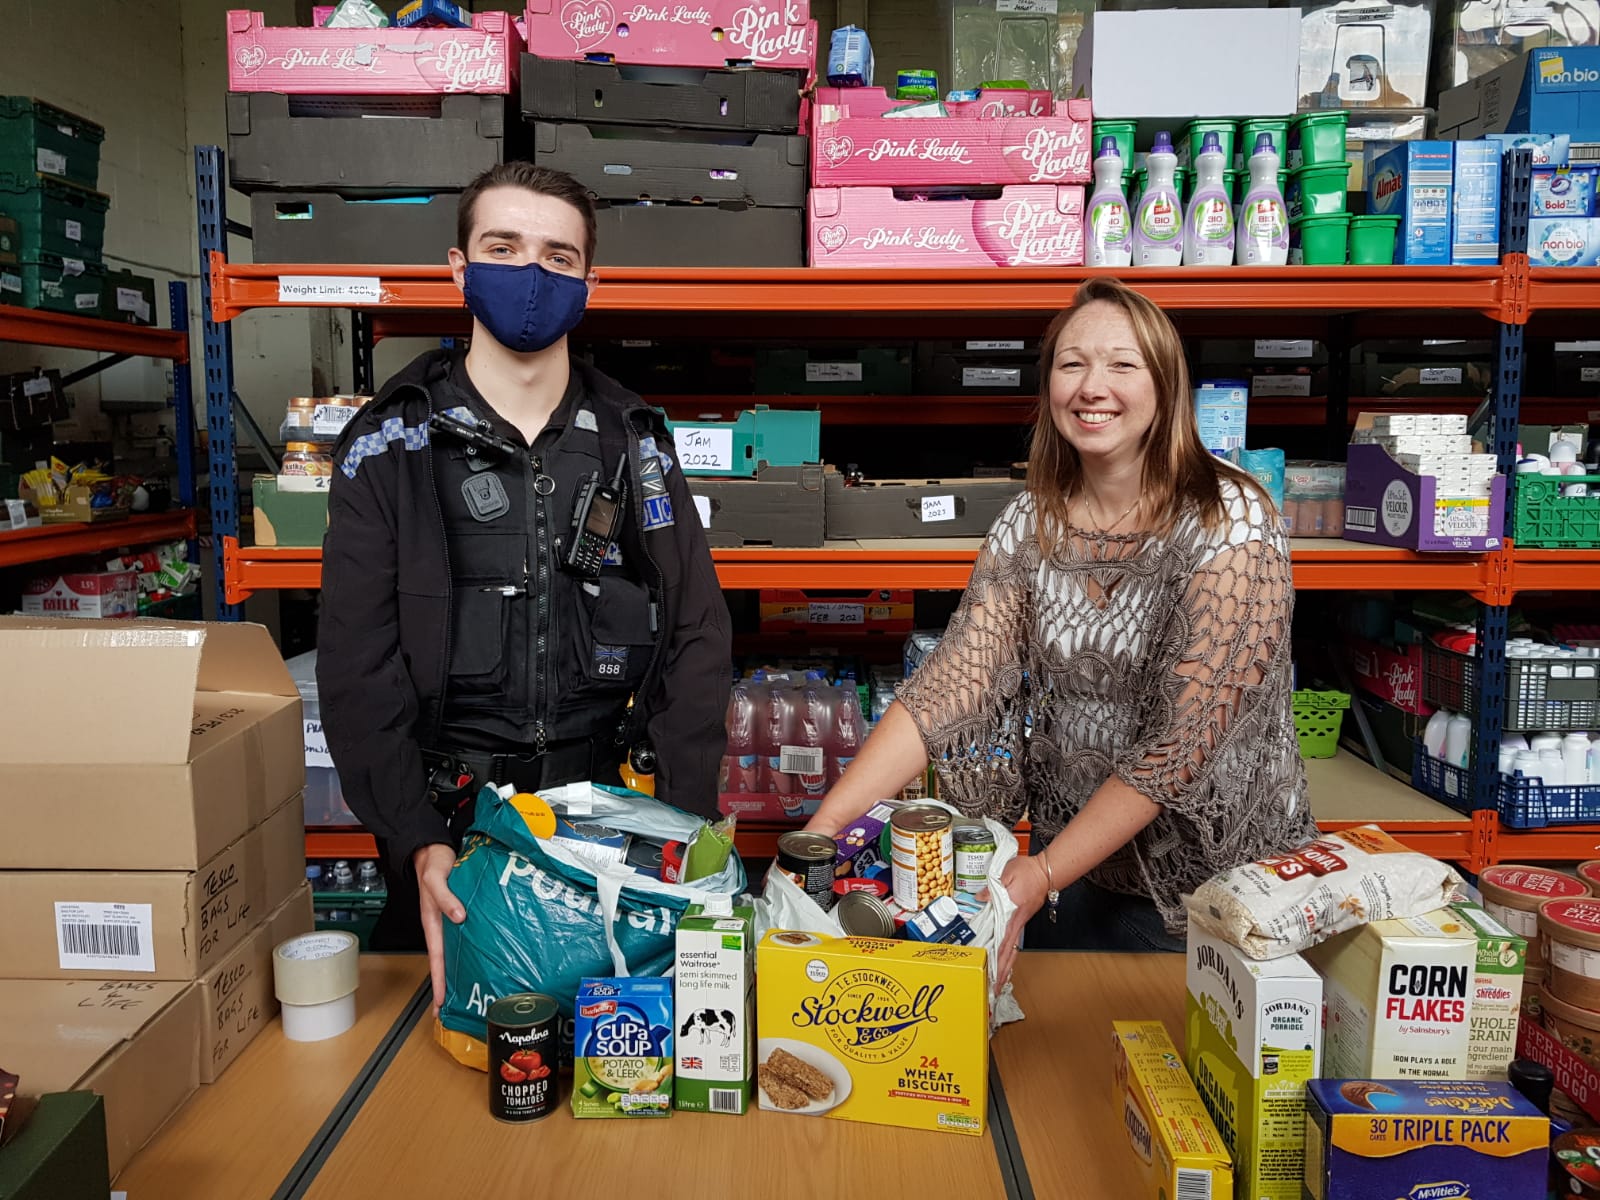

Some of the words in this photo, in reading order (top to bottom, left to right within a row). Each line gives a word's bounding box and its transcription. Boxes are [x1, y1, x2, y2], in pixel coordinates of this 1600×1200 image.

[570, 6, 602, 28] Pink
[623, 5, 669, 23] Pink
[670, 6, 711, 26] Lady
[723, 0, 801, 43] Pink
[577, 20, 609, 39] Lady
[743, 27, 808, 61] Lady
[268, 48, 329, 70] Pink
[332, 48, 386, 74] Lay
[417, 36, 498, 72] Pink
[443, 61, 505, 92] Lady
[1574, 68, 1599, 82] bio
[1003, 123, 1085, 159] Pink
[855, 138, 918, 161] Pink
[918, 138, 973, 164] Lady
[1029, 148, 1089, 182] Lady
[1545, 200, 1566, 209] Bold
[850, 228, 913, 250] Pink
[912, 227, 969, 252] Lady
[1007, 222, 1082, 265] Lady
[1543, 240, 1564, 249] non
[1566, 239, 1584, 249] bio
[283, 285, 316, 296] Weight
[320, 285, 344, 294] Limit:
[684, 431, 711, 447] JAM
[683, 453, 721, 466] 2022
[642, 496, 674, 526] OLIC
[923, 500, 941, 509] JAM
[1386, 501, 1409, 514] VELOUR
[1448, 521, 1478, 529] VELOUR
[43, 598, 79, 611] MILK
[810, 613, 829, 622] FEB
[599, 664, 620, 674] 858
[1384, 663, 1414, 685] Pink
[1392, 686, 1416, 706] Lady
[200, 900, 229, 931] BAGS
[200, 930, 219, 957] FOR
[680, 952, 717, 960] essential
[680, 960, 720, 968] Waitrose
[213, 963, 245, 1000] TESCO
[680, 971, 699, 979] semi
[700, 971, 738, 981] skimmed
[1197, 944, 1245, 1020] JORDANS
[1388, 964, 1468, 998] CORN
[679, 980, 699, 990] long
[700, 980, 713, 989] life
[714, 981, 731, 989] milk
[1476, 988, 1511, 999] Shreddies
[217, 992, 243, 1030] BAGS
[791, 984, 945, 1027] Stockwell
[1264, 1001, 1311, 1017] JORDANS
[1386, 998, 1465, 1023] FLAKES
[1273, 1016, 1303, 1024] ORGANIC
[499, 1027, 550, 1046] Napolina
[1398, 1025, 1409, 1034] by
[1409, 1026, 1450, 1035] Sainsbury's
[212, 1038, 229, 1064] FOR
[596, 1040, 652, 1056] SOUP
[830, 1029, 841, 1043] FOR
[843, 1044, 877, 1059] QUALITY
[888, 1037, 909, 1055] VALUE
[1490, 1045, 1512, 1054] main
[602, 1058, 644, 1069] POTATO
[920, 1056, 939, 1069] 24
[1393, 1055, 1409, 1063] IRON
[1411, 1056, 1433, 1064] PLAYS
[1434, 1057, 1440, 1065] A
[1468, 1053, 1508, 1061] ngredient
[1519, 1018, 1600, 1095] UPER-LICIO
[606, 1070, 615, 1078] &
[617, 1069, 640, 1078] LEEK
[904, 1067, 954, 1083] WHEAT
[1423, 1069, 1449, 1077] NORMAL
[501, 1080, 548, 1098] CHOPPED
[898, 1078, 961, 1094] BISCUITS
[1199, 1056, 1235, 1124] ORGANIC
[1556, 1065, 1569, 1088] TO
[1571, 1079, 1587, 1103] GO
[506, 1094, 545, 1106] TOMATOES
[682, 1100, 695, 1108] litre
[1370, 1119, 1388, 1133] 30
[1393, 1119, 1454, 1142] TRIPLE
[1461, 1120, 1511, 1144] PACK
[1418, 1187, 1460, 1200] McVitie's
